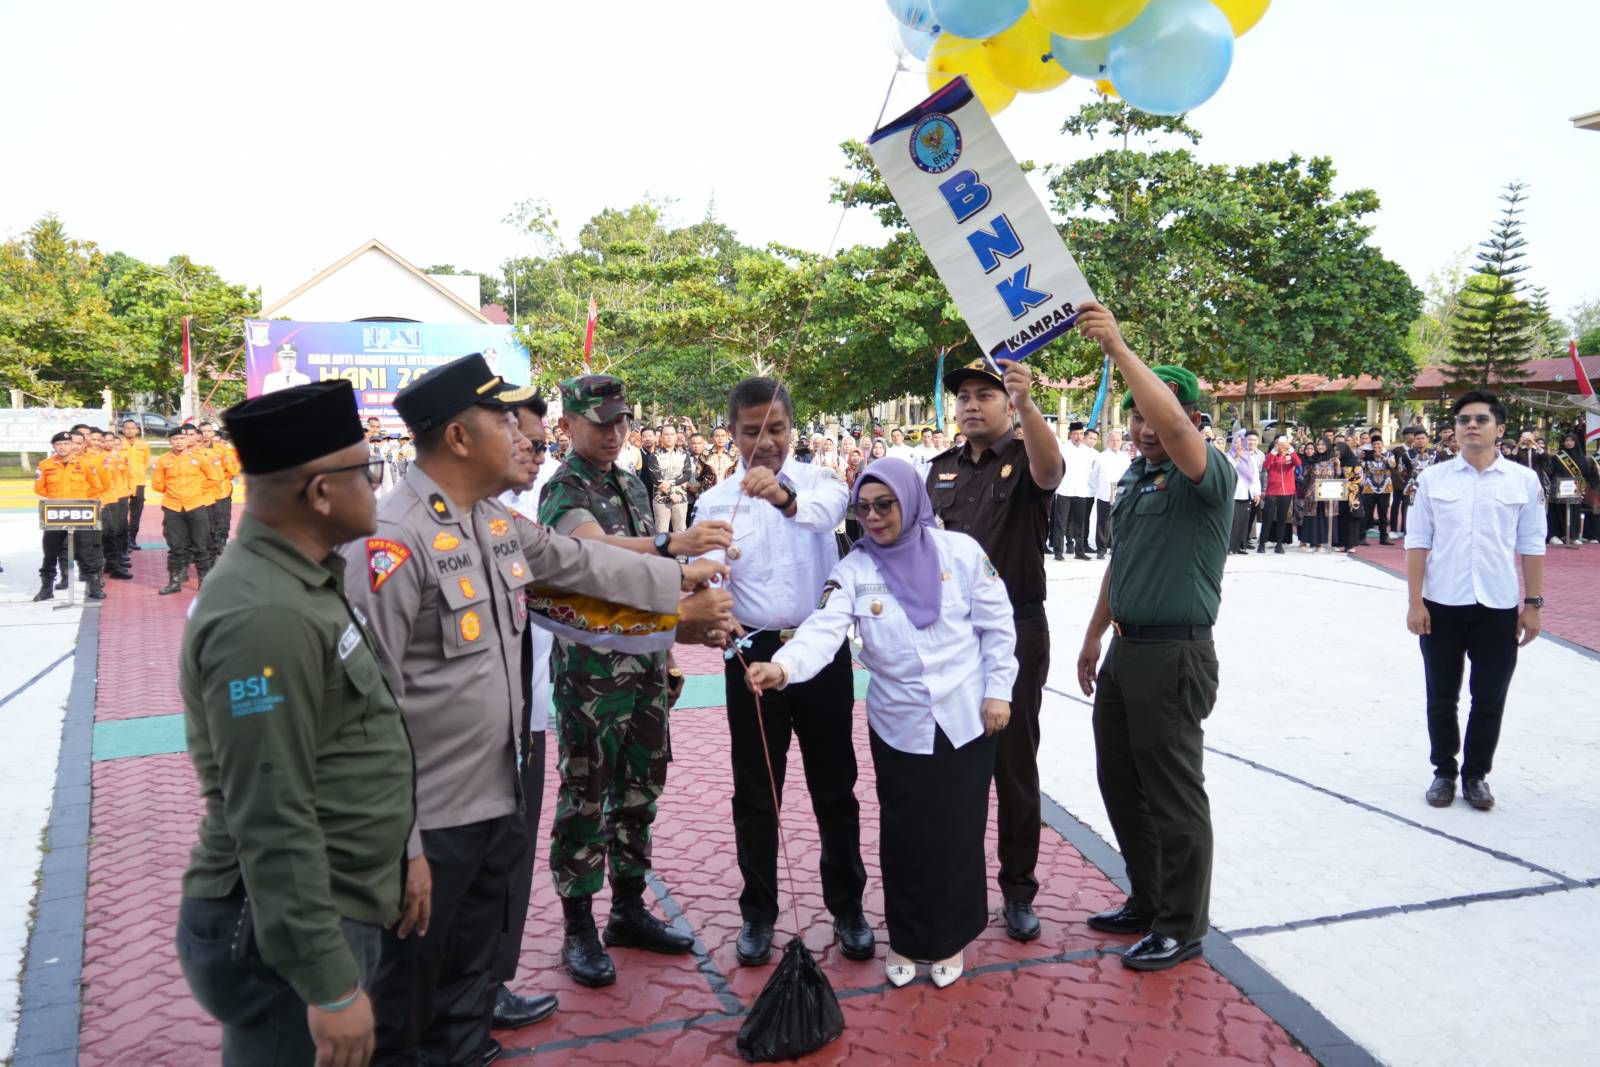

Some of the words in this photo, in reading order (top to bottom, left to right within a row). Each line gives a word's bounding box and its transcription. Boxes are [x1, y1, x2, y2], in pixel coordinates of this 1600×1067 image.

[933, 147, 952, 165] BNK
[938, 168, 1052, 321] BNK
[1006, 302, 1076, 351] KAMPAR
[47, 509, 94, 520] BPBD
[492, 540, 519, 558] POLRI
[437, 553, 473, 574] ROMI
